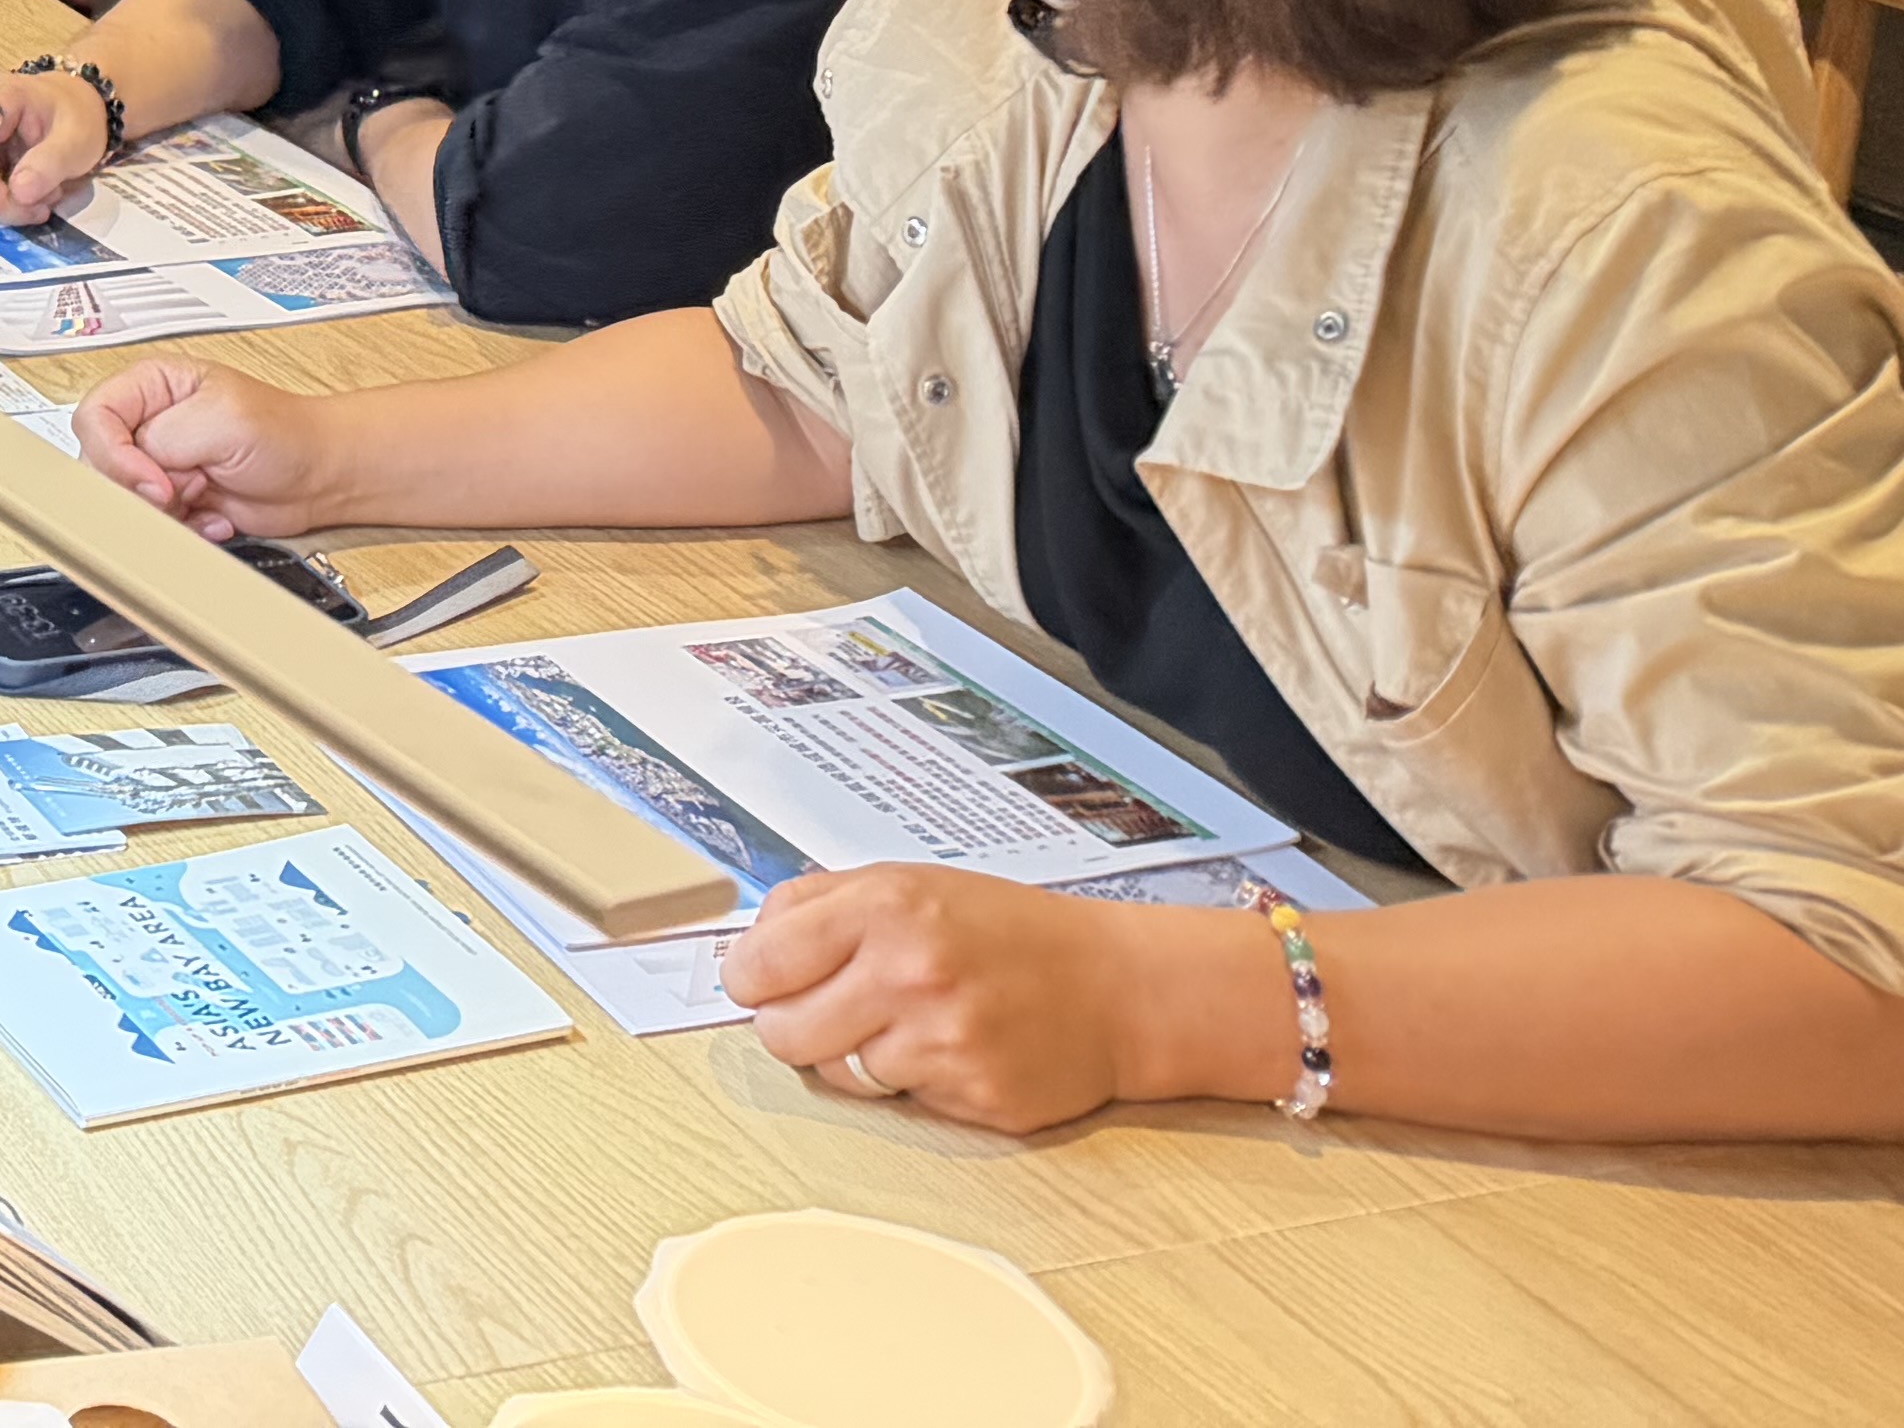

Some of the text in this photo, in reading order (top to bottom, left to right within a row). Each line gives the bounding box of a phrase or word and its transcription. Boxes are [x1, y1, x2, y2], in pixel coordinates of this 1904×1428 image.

[119, 896, 185, 946] AREA
[172, 955, 232, 992] BAY
[171, 989, 257, 1050] ASIA'S
[220, 998, 292, 1046] NEW
